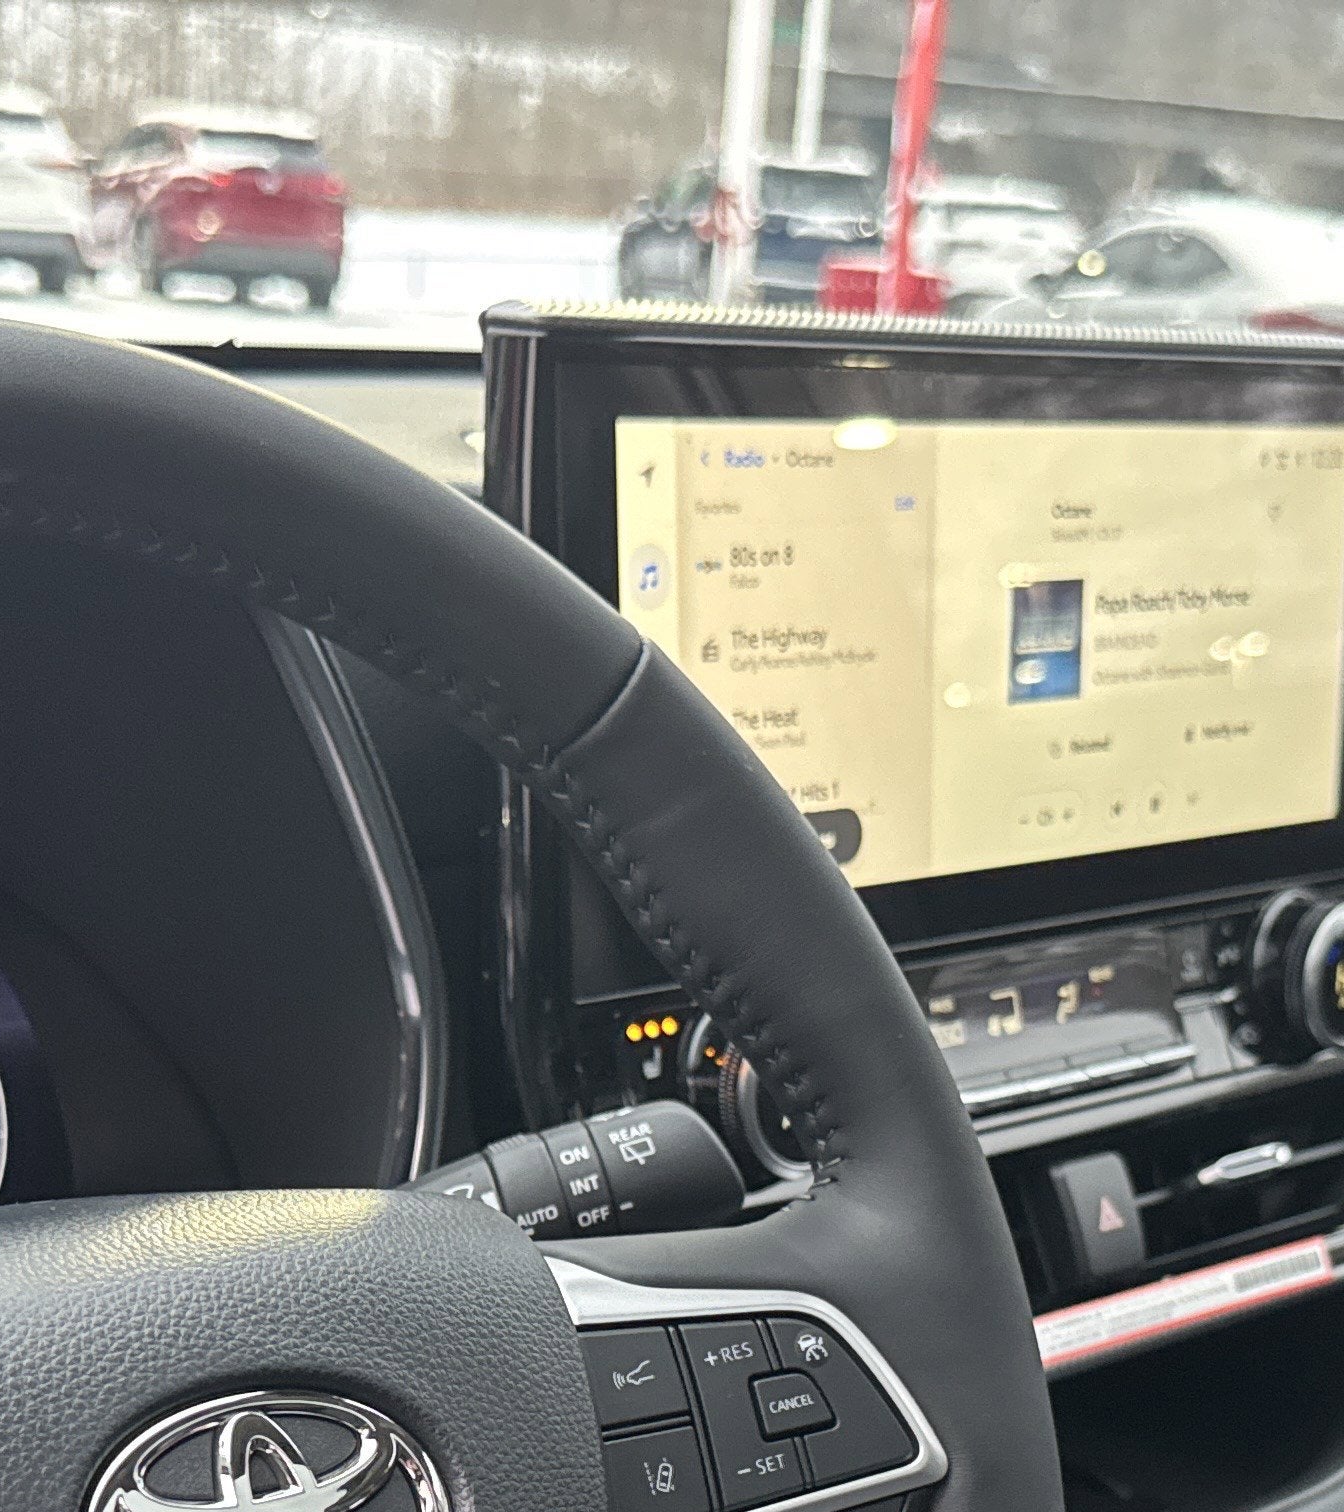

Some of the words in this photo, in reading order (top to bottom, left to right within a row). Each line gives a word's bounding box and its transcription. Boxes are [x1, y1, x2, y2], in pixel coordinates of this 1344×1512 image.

[731, 628, 759, 650] The
[607, 1122, 653, 1146] REAR
[559, 1146, 590, 1166] ON
[569, 1175, 600, 1197] INT
[516, 1206, 559, 1228] AUTO
[577, 1206, 611, 1228] OFF
[768, 1393, 815, 1415] CANCEL
